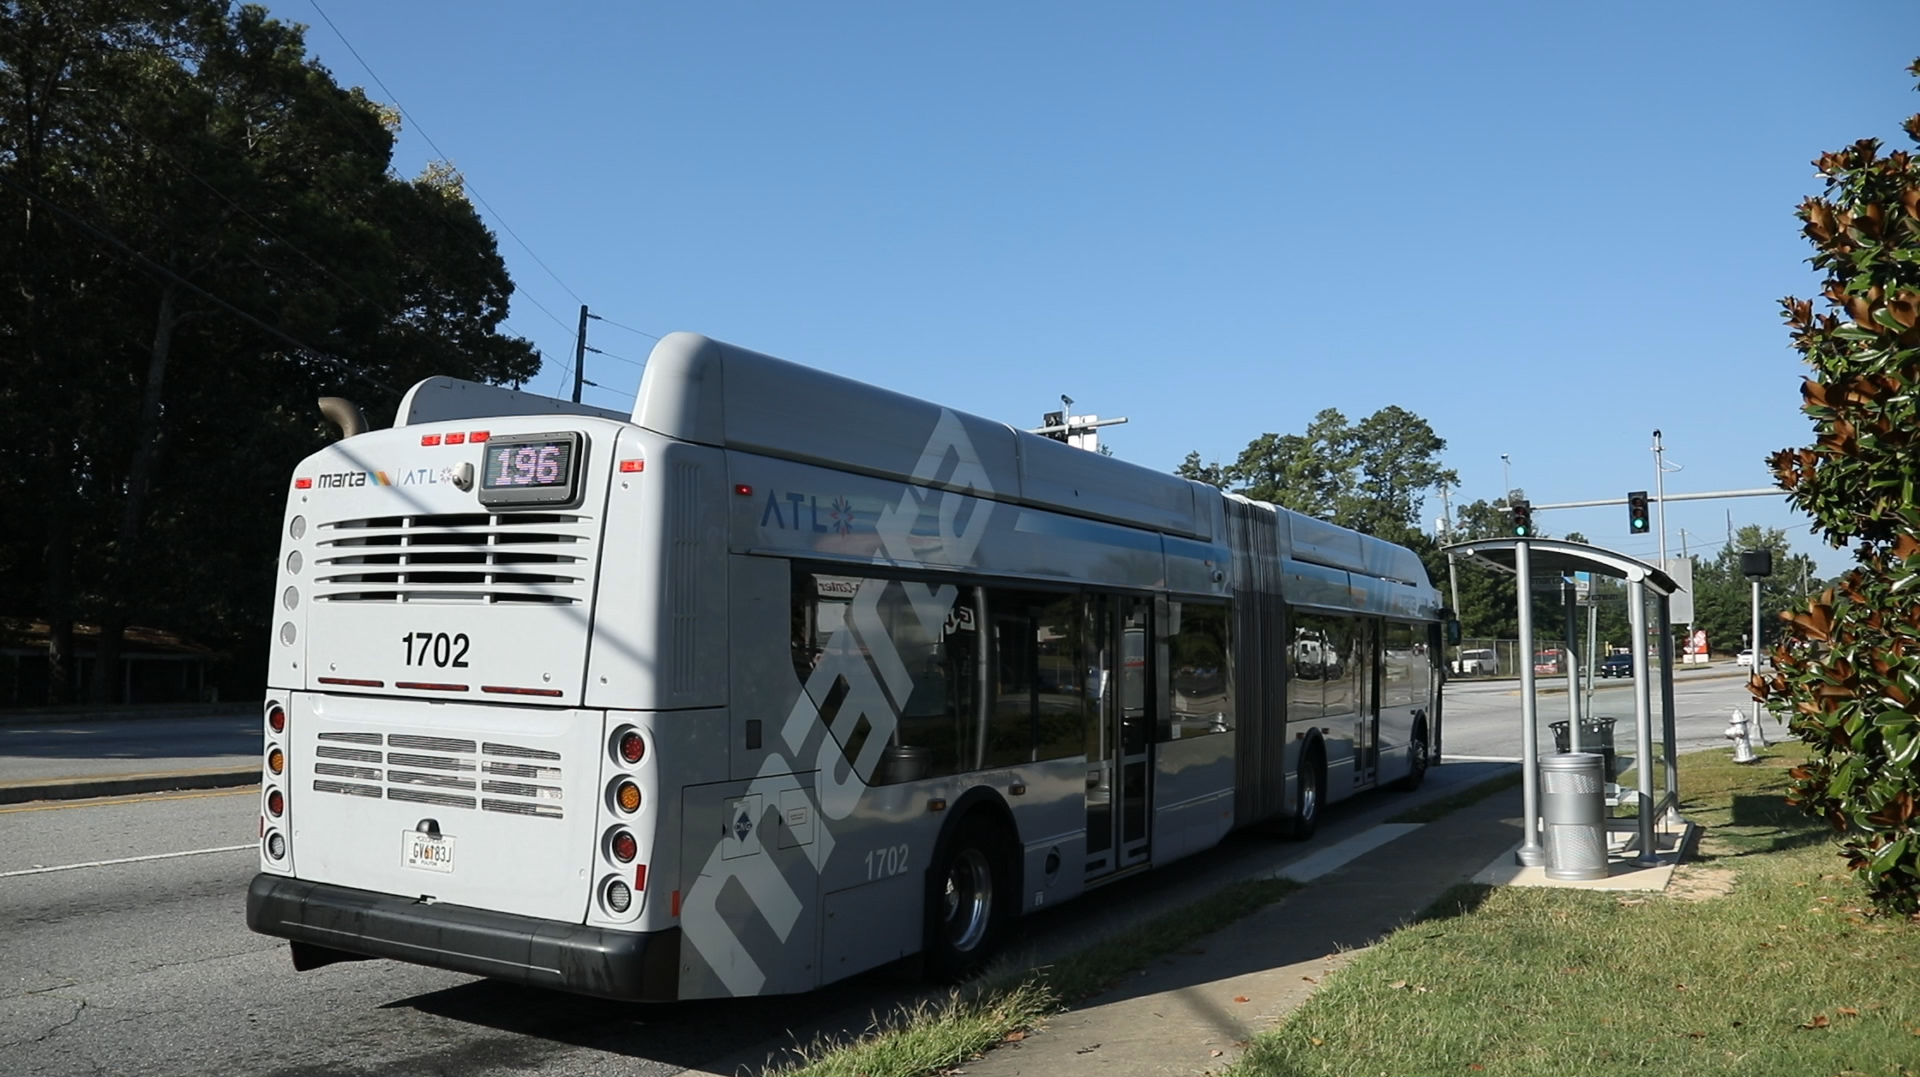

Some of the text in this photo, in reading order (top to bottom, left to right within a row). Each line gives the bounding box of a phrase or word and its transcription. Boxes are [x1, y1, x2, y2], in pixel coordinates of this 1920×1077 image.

[317, 468, 437, 489] marta ATL
[495, 445, 560, 486] 196
[760, 488, 828, 533] ATL
[402, 631, 470, 668] 1702
[735, 820, 753, 833] CNG
[864, 843, 909, 881] 1702
